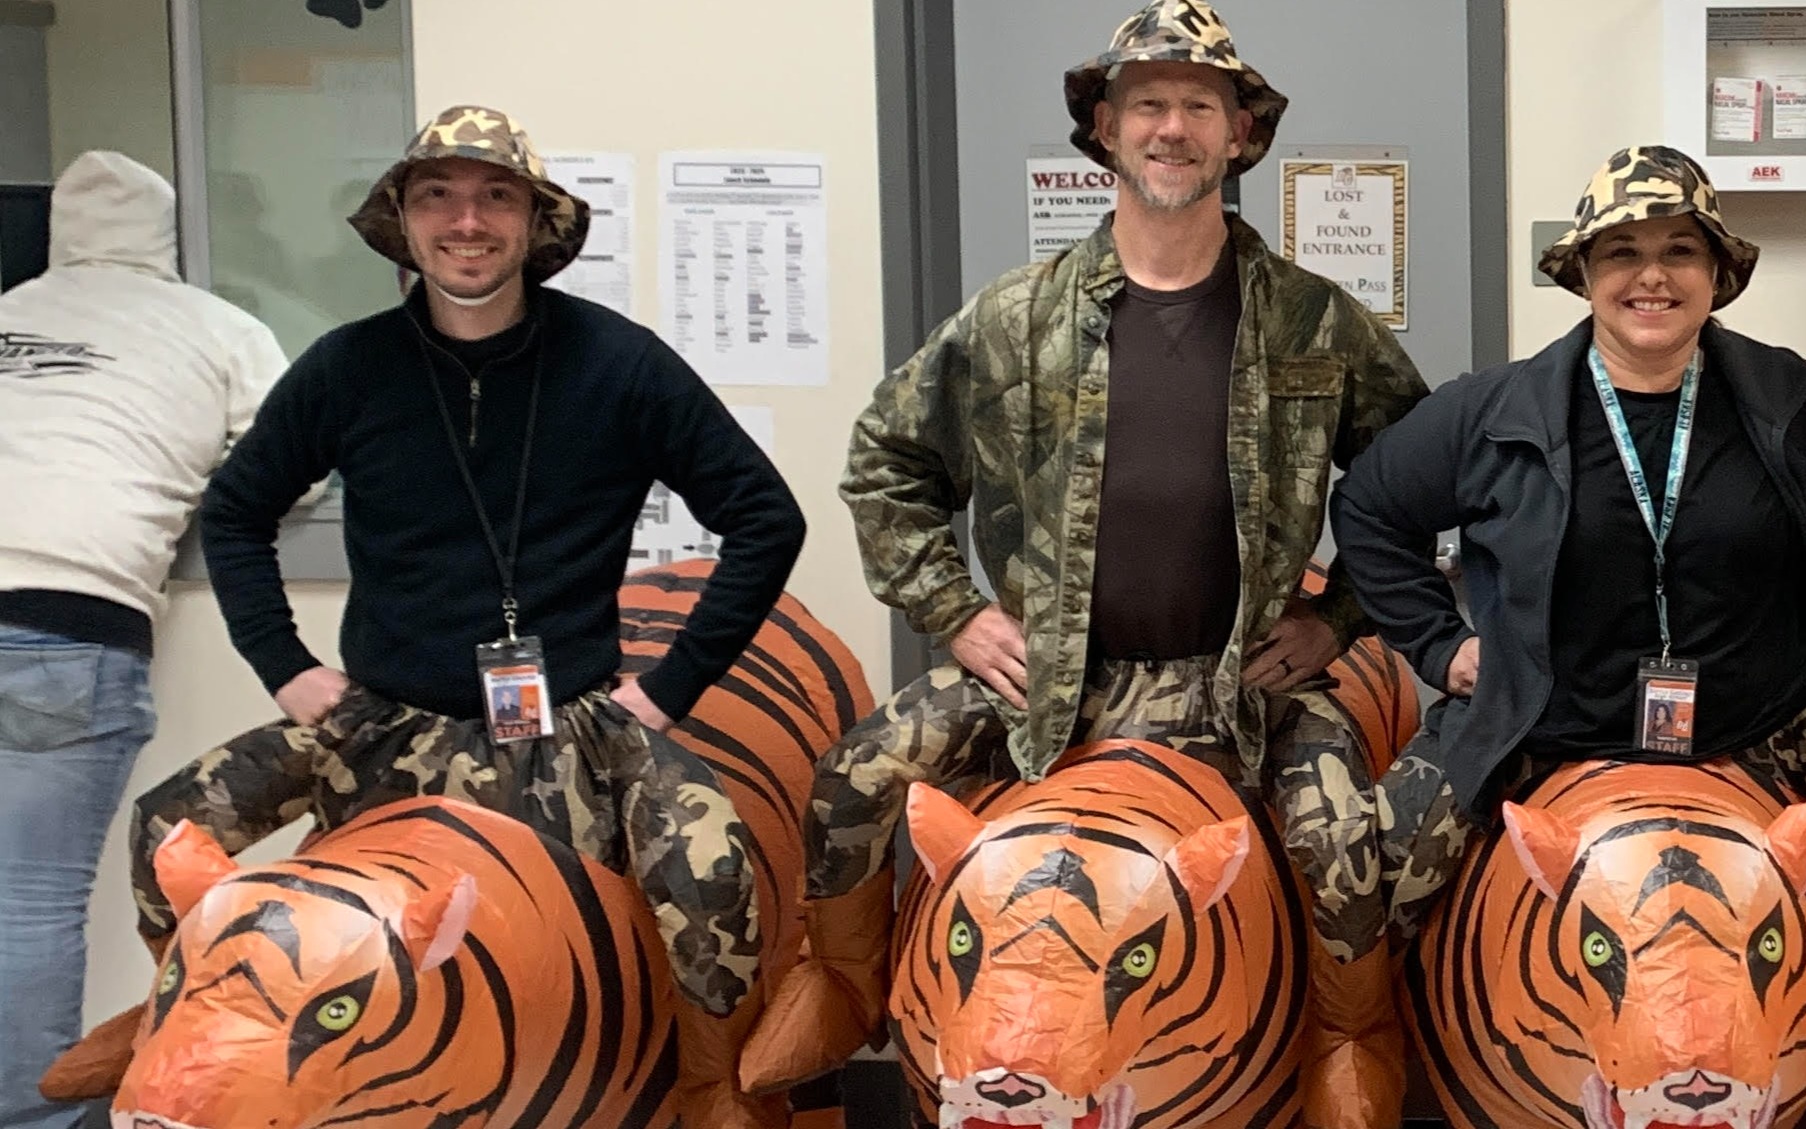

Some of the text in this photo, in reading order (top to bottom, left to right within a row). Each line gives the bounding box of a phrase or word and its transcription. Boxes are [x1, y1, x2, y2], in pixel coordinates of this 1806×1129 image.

[1752, 167, 1780, 177] AEK
[1032, 172, 1116, 189] WELCO
[1034, 198, 1045, 206] IF
[1049, 197, 1072, 206] YOU
[1325, 191, 1364, 202] LOST
[1338, 209, 1350, 220] &
[1316, 225, 1372, 238] FOUND
[1303, 243, 1386, 256] ENTRANCE
[495, 726, 539, 738] STAFF
[1646, 740, 1688, 754] STAFF
